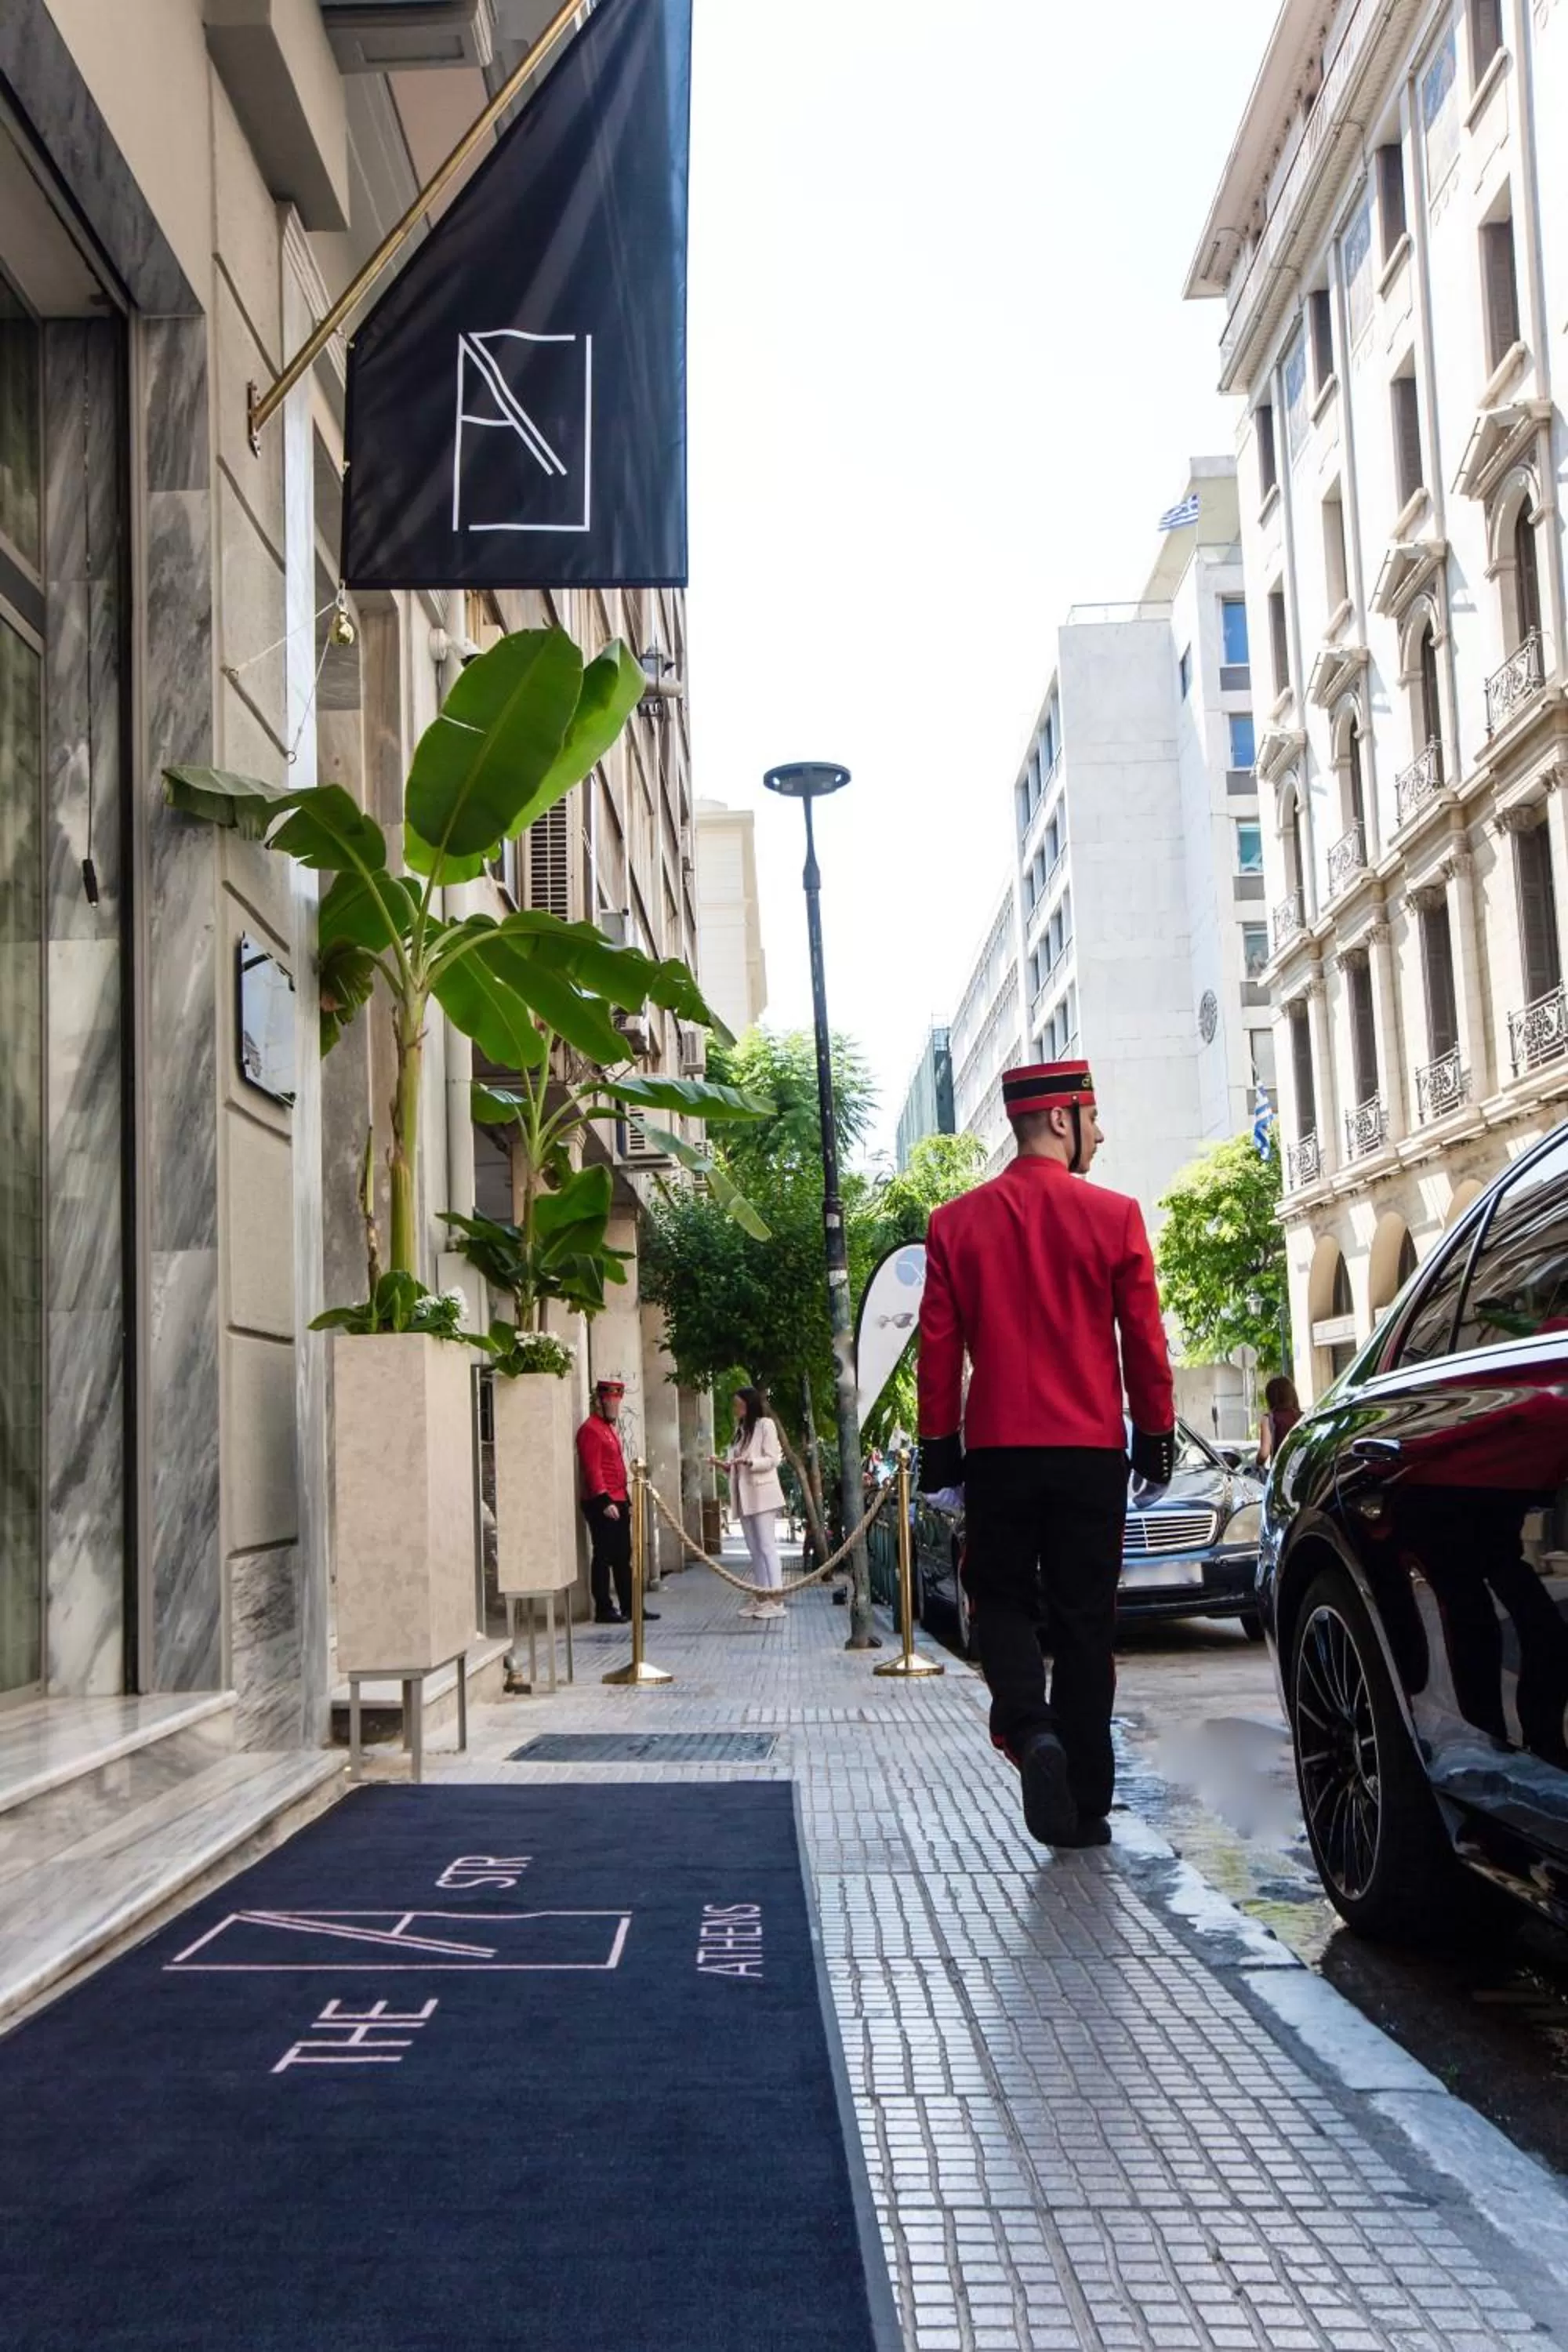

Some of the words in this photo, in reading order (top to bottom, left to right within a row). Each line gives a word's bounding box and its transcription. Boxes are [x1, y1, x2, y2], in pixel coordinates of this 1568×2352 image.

[270, 1998, 439, 2074] THE
[435, 1856, 532, 1889] STR
[696, 1903, 763, 1978] ATHENS
